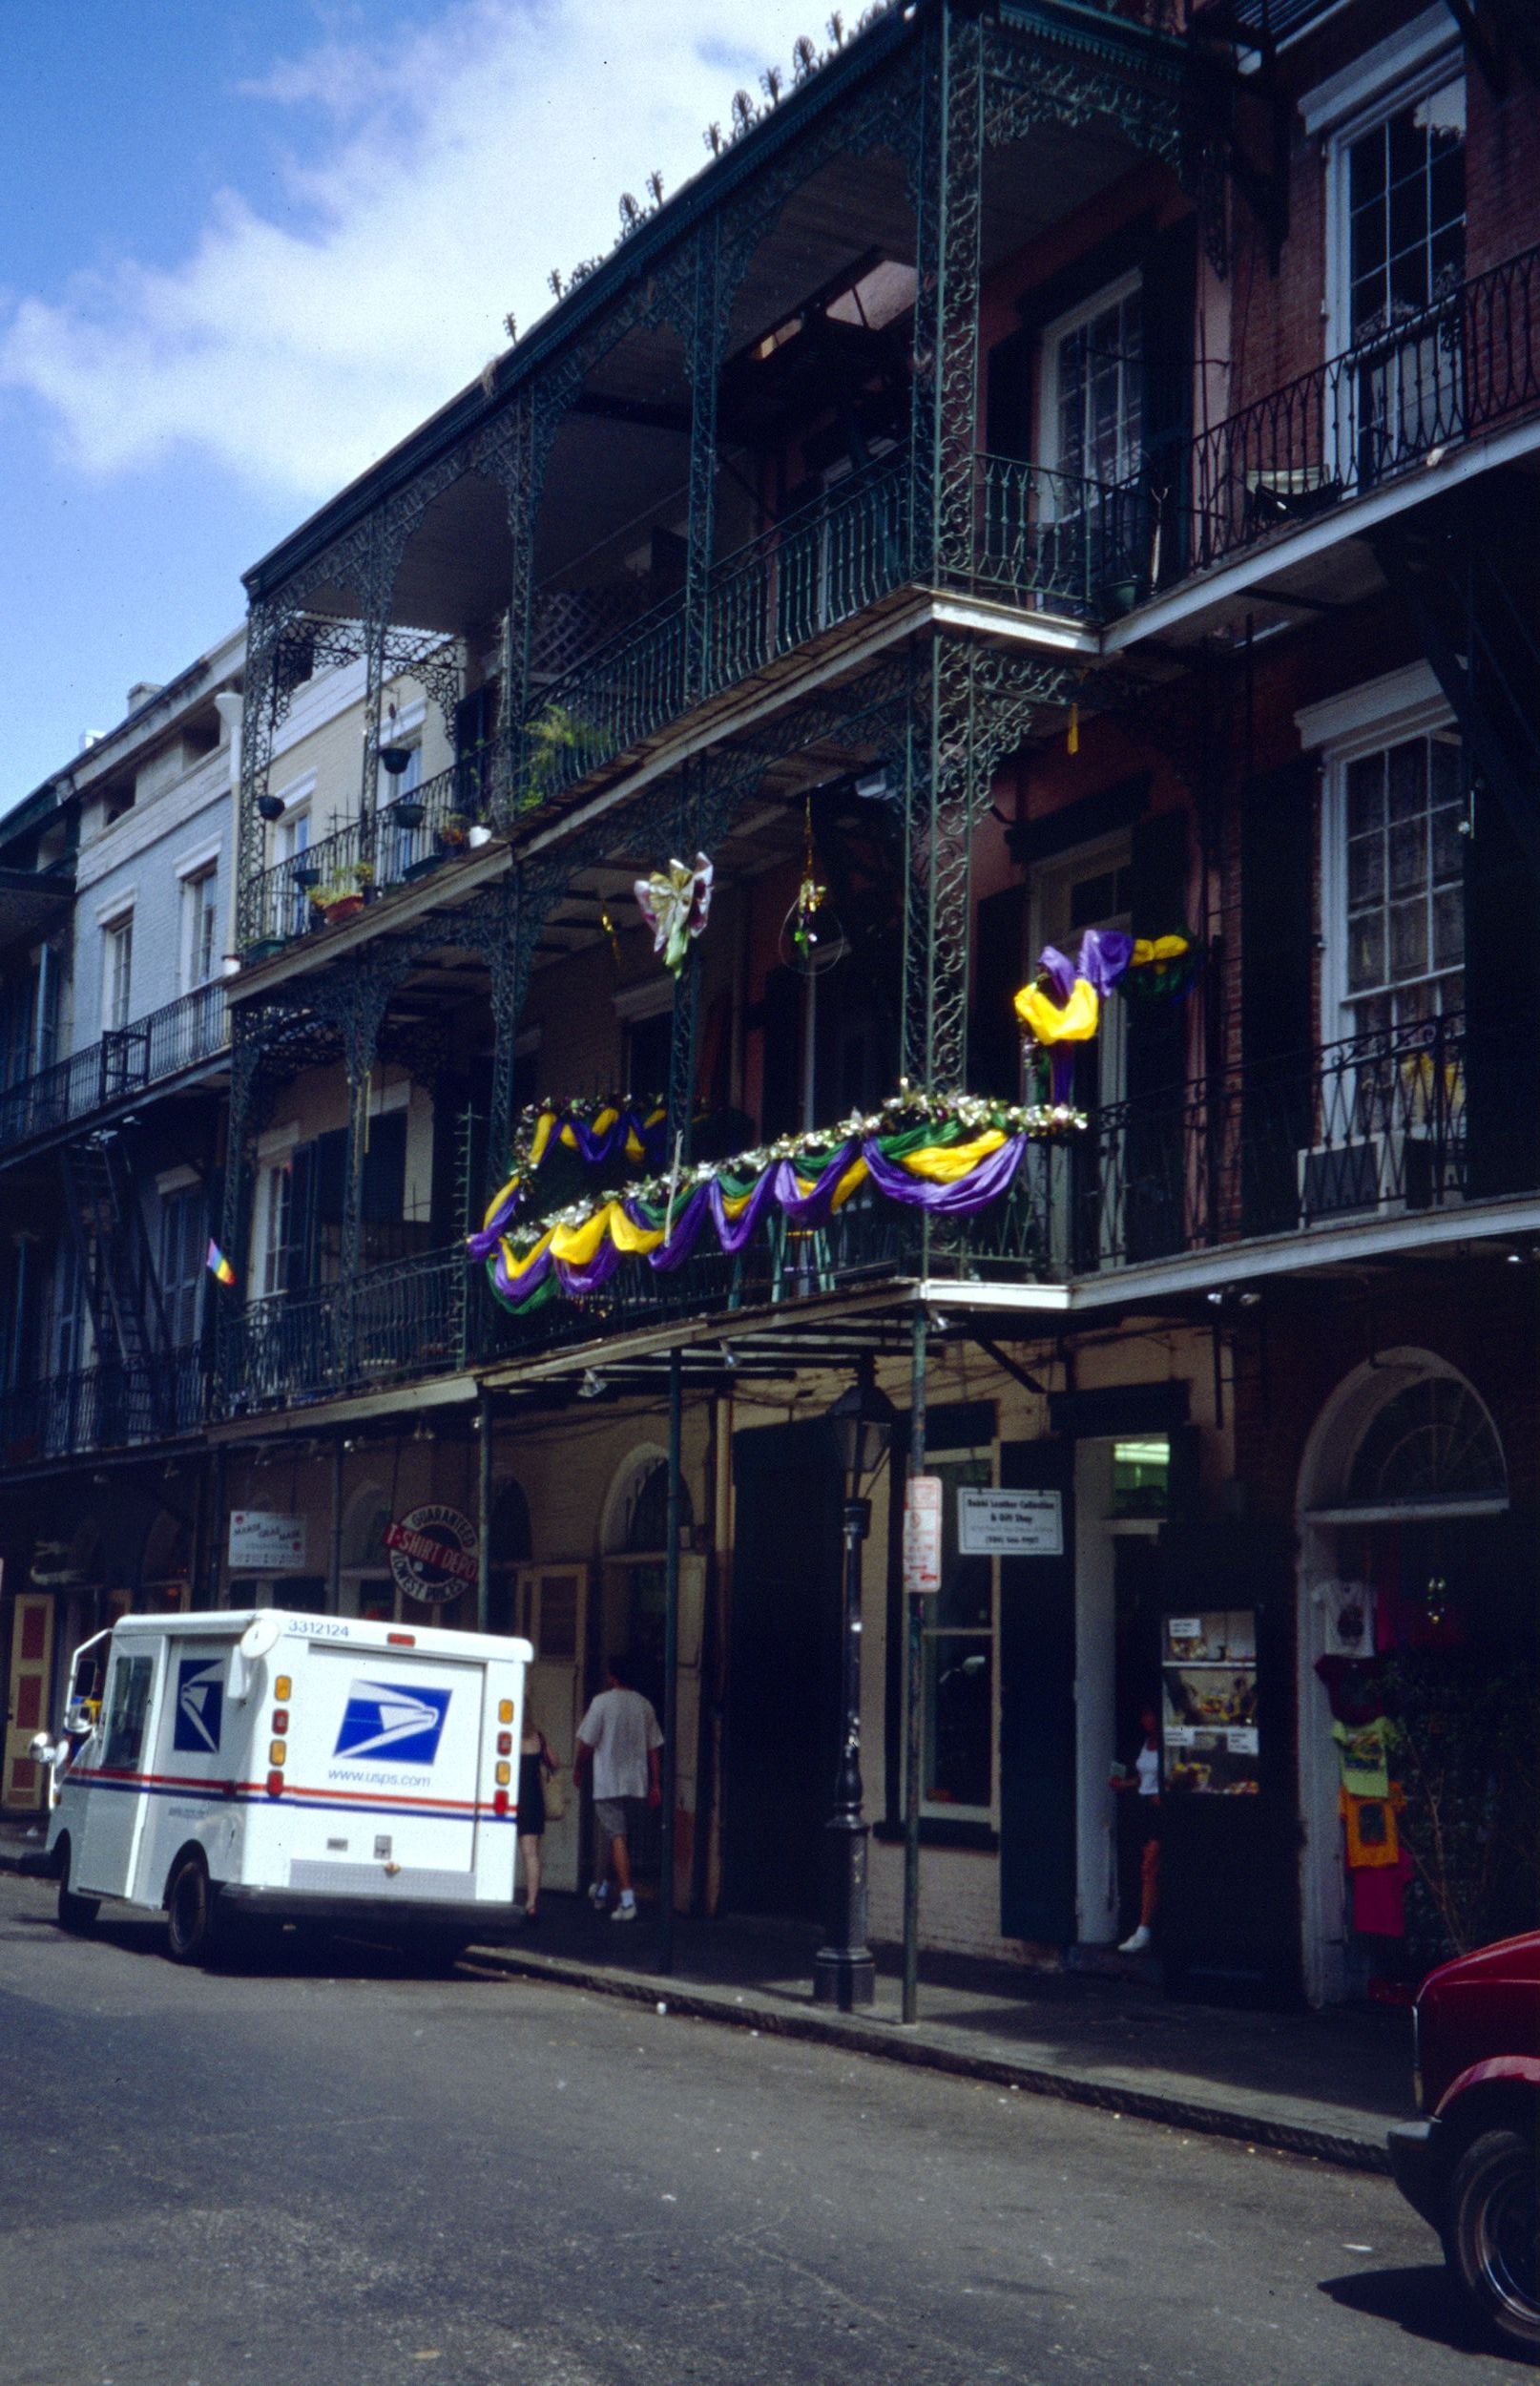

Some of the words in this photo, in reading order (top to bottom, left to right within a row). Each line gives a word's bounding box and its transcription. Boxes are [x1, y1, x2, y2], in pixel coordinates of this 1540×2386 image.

[411, 1507, 476, 1548] GUARANTEED
[1015, 1514, 1033, 1525] Shop
[441, 1548, 478, 1580] DEPO
[391, 1554, 426, 1597] LOWEST
[425, 1577, 465, 1601] PRICES
[288, 1619, 349, 1638] 3312124
[327, 1769, 431, 1788] www.usps.com
